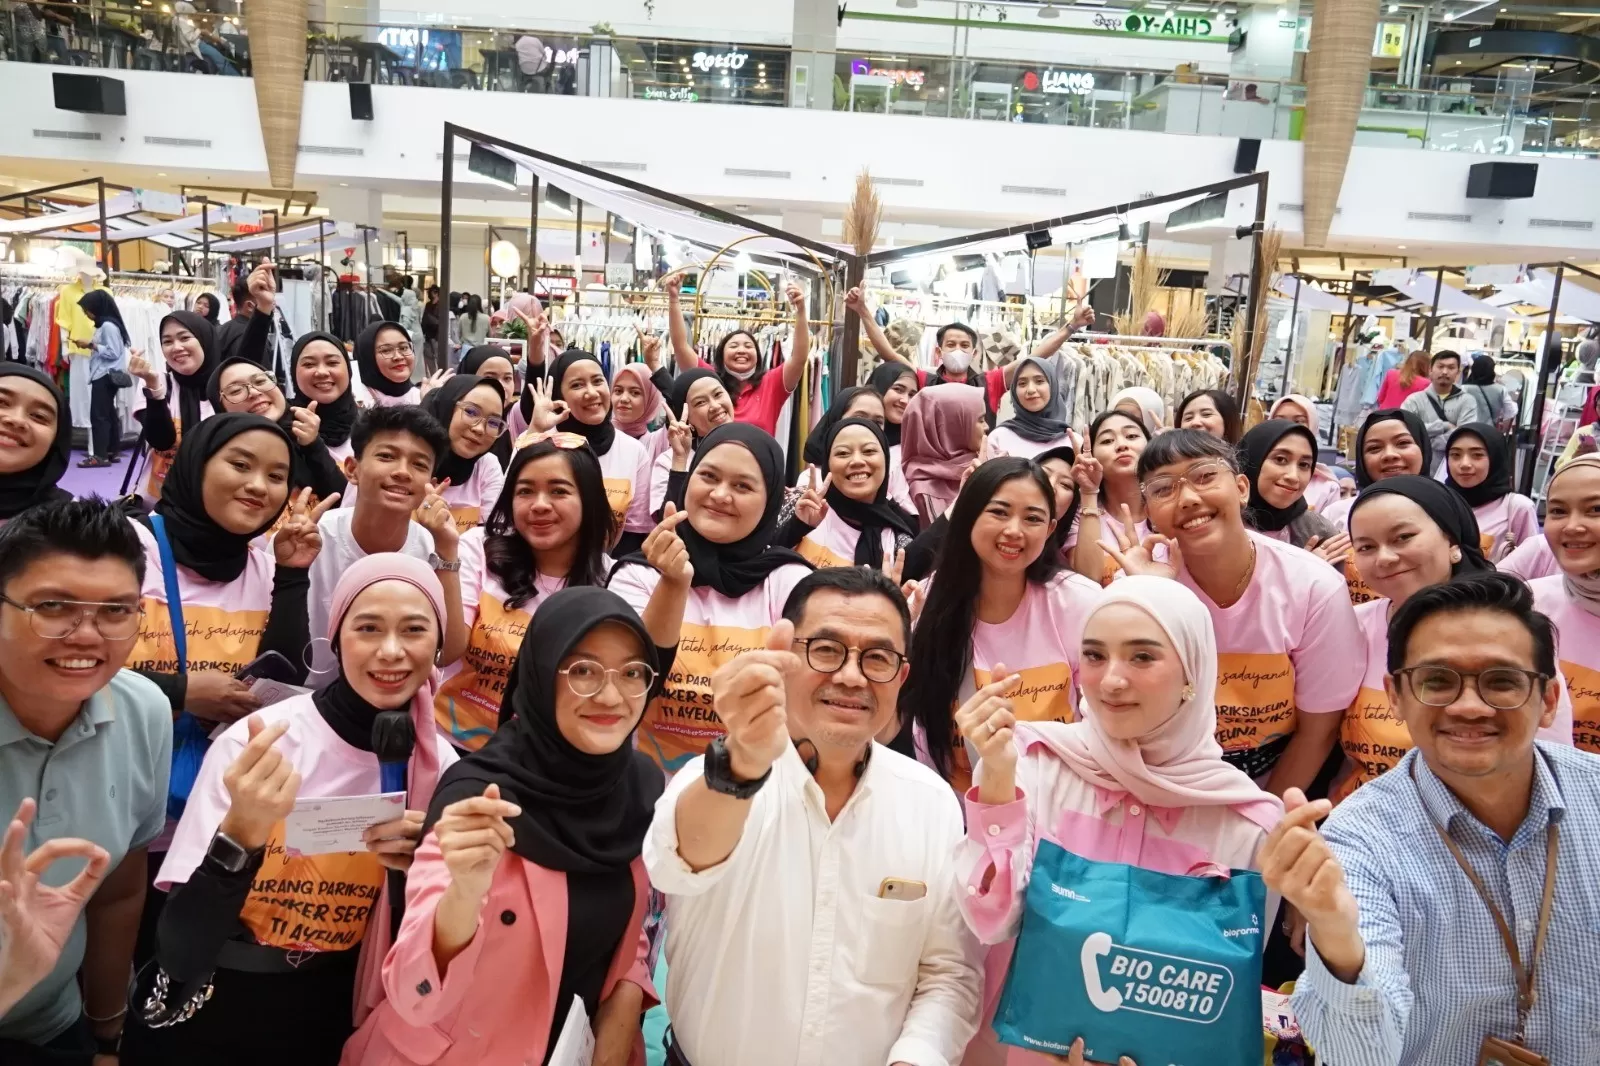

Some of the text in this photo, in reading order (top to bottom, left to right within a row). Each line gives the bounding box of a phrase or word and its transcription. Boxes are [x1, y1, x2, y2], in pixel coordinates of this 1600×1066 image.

[204, 622, 264, 644] sadayan
[677, 706, 724, 724] AYEUN
[1215, 699, 1289, 718] RIKSAKEUN
[332, 905, 370, 924] SER
[271, 917, 288, 936] TI
[1109, 954, 1224, 995] BIO CARE
[1124, 981, 1214, 1011] 1500810
